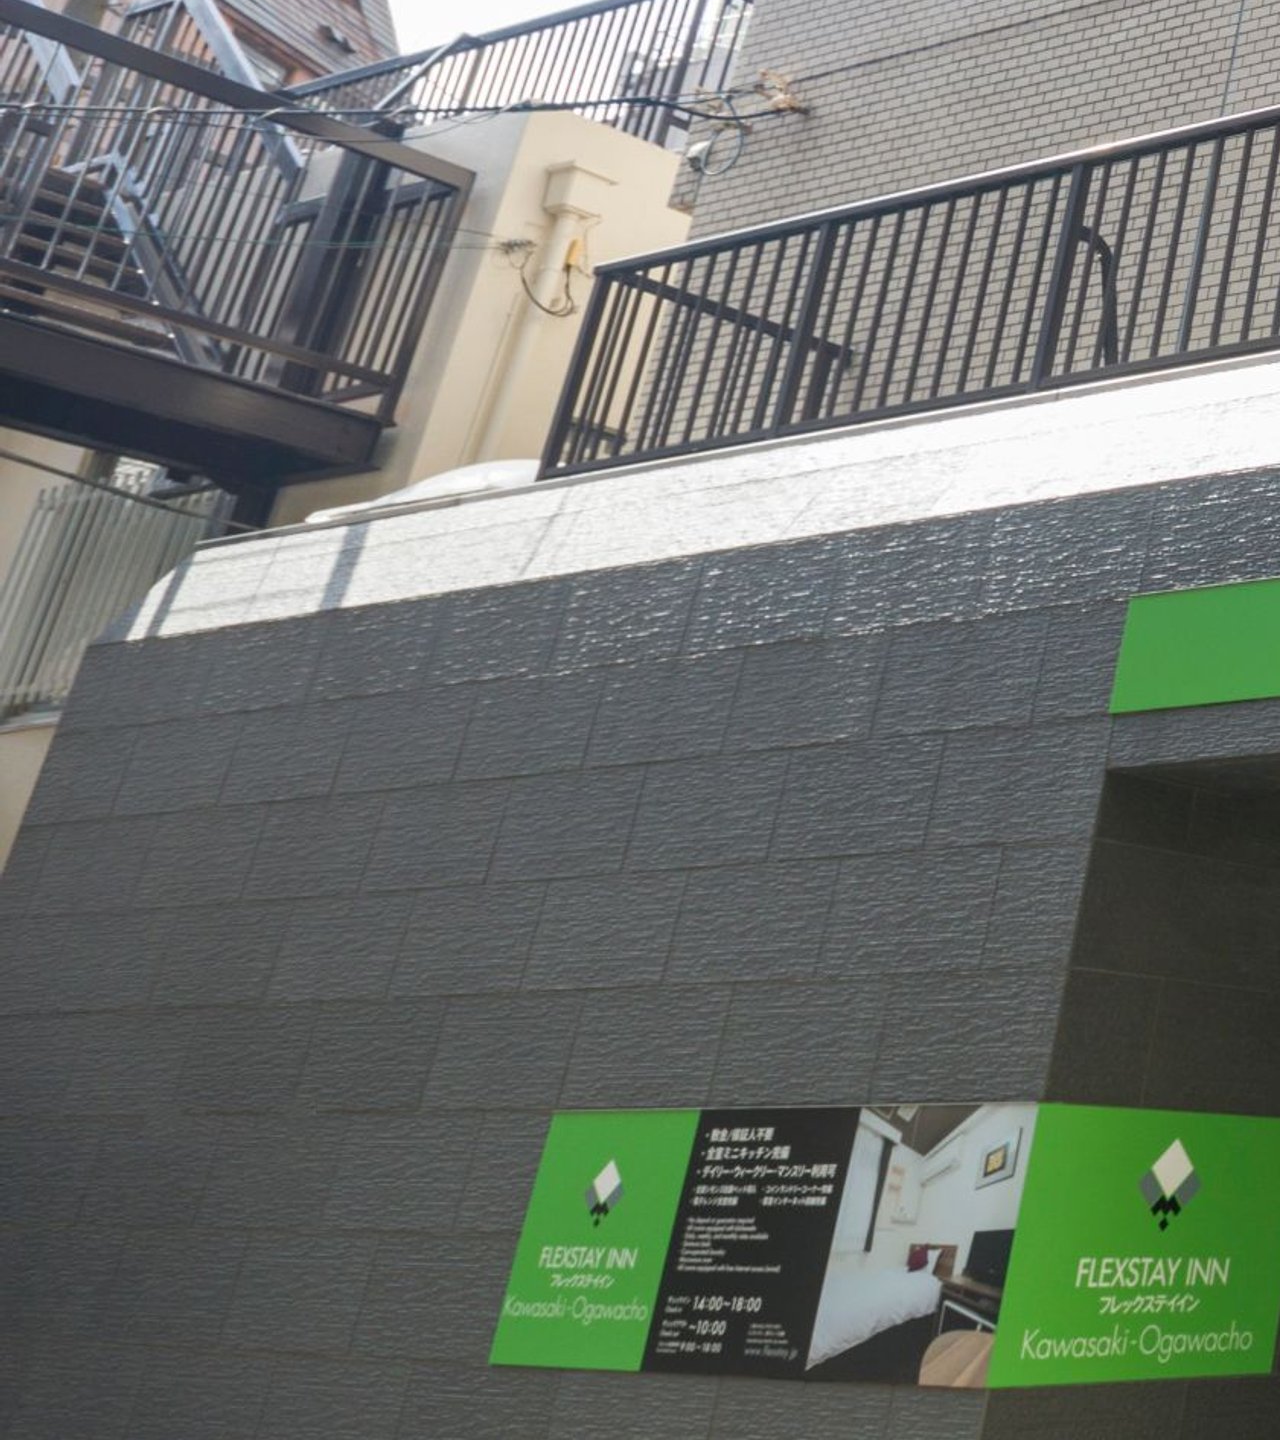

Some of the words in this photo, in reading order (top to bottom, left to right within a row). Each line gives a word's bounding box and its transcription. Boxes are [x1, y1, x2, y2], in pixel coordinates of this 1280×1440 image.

[538, 1246, 605, 1269] FLEXSTAY
[606, 1248, 638, 1270] INN
[1075, 1257, 1182, 1288] FLEXSTAY
[1186, 1257, 1230, 1286] INN
[503, 1295, 648, 1326] Kawasaki-Ogawacho
[1100, 1293, 1200, 1314] フレックステイイン
[1020, 1321, 1253, 1364] Kawasaki-Ogawacho
